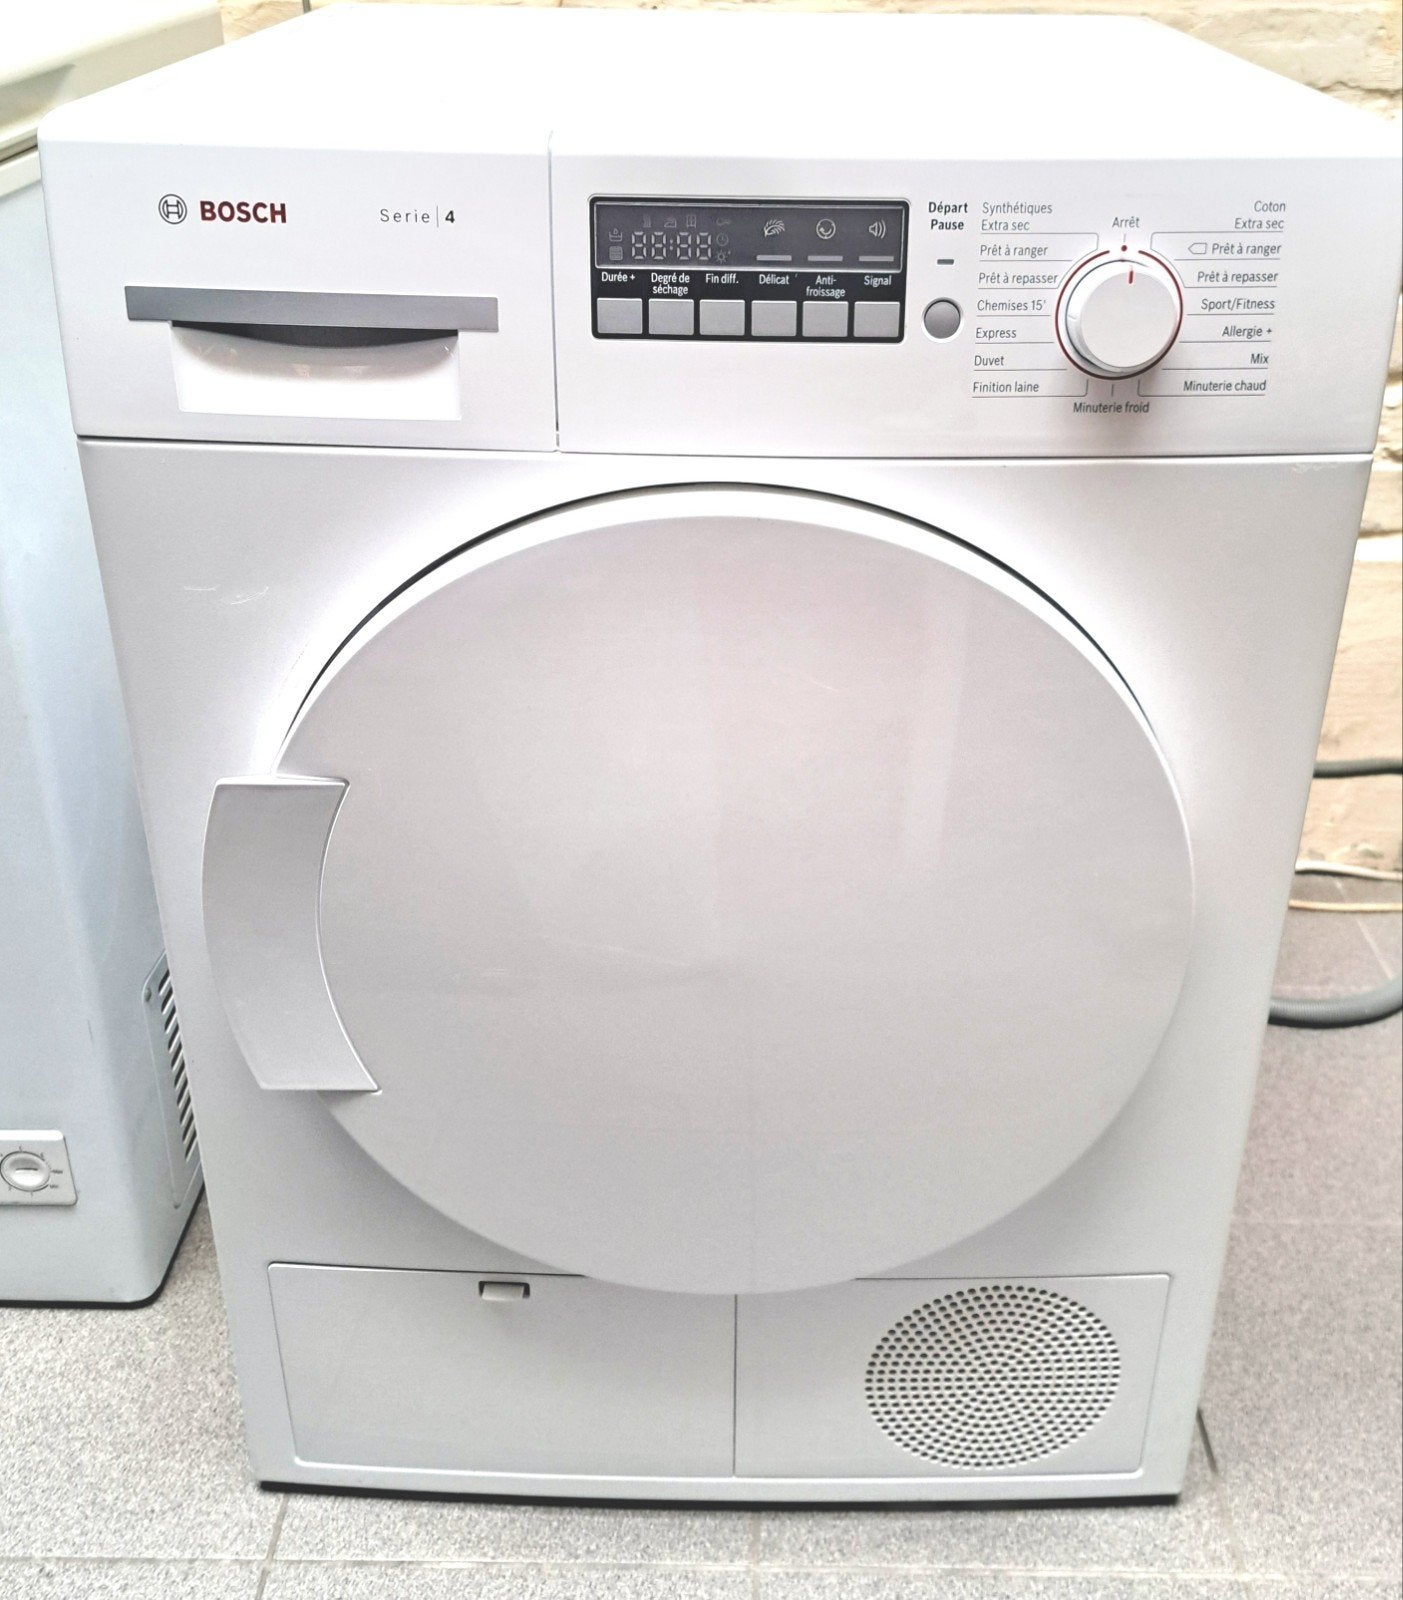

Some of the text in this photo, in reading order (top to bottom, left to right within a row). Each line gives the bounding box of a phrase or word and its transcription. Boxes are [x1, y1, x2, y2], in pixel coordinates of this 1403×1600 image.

[200, 200, 287, 223] BOSCH
[928, 201, 968, 215] Départ
[982, 202, 1053, 215] Synthétiques
[1254, 201, 1286, 212] Coton
[380, 208, 455, 223] Serie 4
[930, 219, 964, 230] Pause
[981, 219, 1030, 231] Extra sec
[1112, 216, 1140, 228] Arrêt
[1234, 218, 1284, 229] Extra sec
[980, 244, 1048, 258] Prêt à ranger
[1211, 243, 1282, 257] Prêt à ranger
[601, 272, 628, 282] Durée
[651, 273, 690, 285] Degré de
[705, 274, 739, 284] Fin diff.
[759, 273, 789, 285] Délicat
[816, 275, 837, 286] Anti-
[864, 275, 892, 288] Signal
[978, 272, 1058, 286] Prêt à repasser
[1197, 271, 1278, 285] Prêt à repasser
[652, 284, 688, 296] séchage
[806, 286, 846, 299] froissage
[977, 300, 1028, 311] Chemises
[1201, 298, 1275, 312] Sport/Fitness
[976, 328, 1017, 341] Express
[1222, 326, 1262, 340] Allergie
[974, 356, 1004, 366] Duvet
[1250, 353, 1269, 364] Mix
[973, 381, 1039, 393] Finition laine
[1183, 380, 1266, 392] Minuterie chaud
[1073, 402, 1150, 413] Minuterie froid
